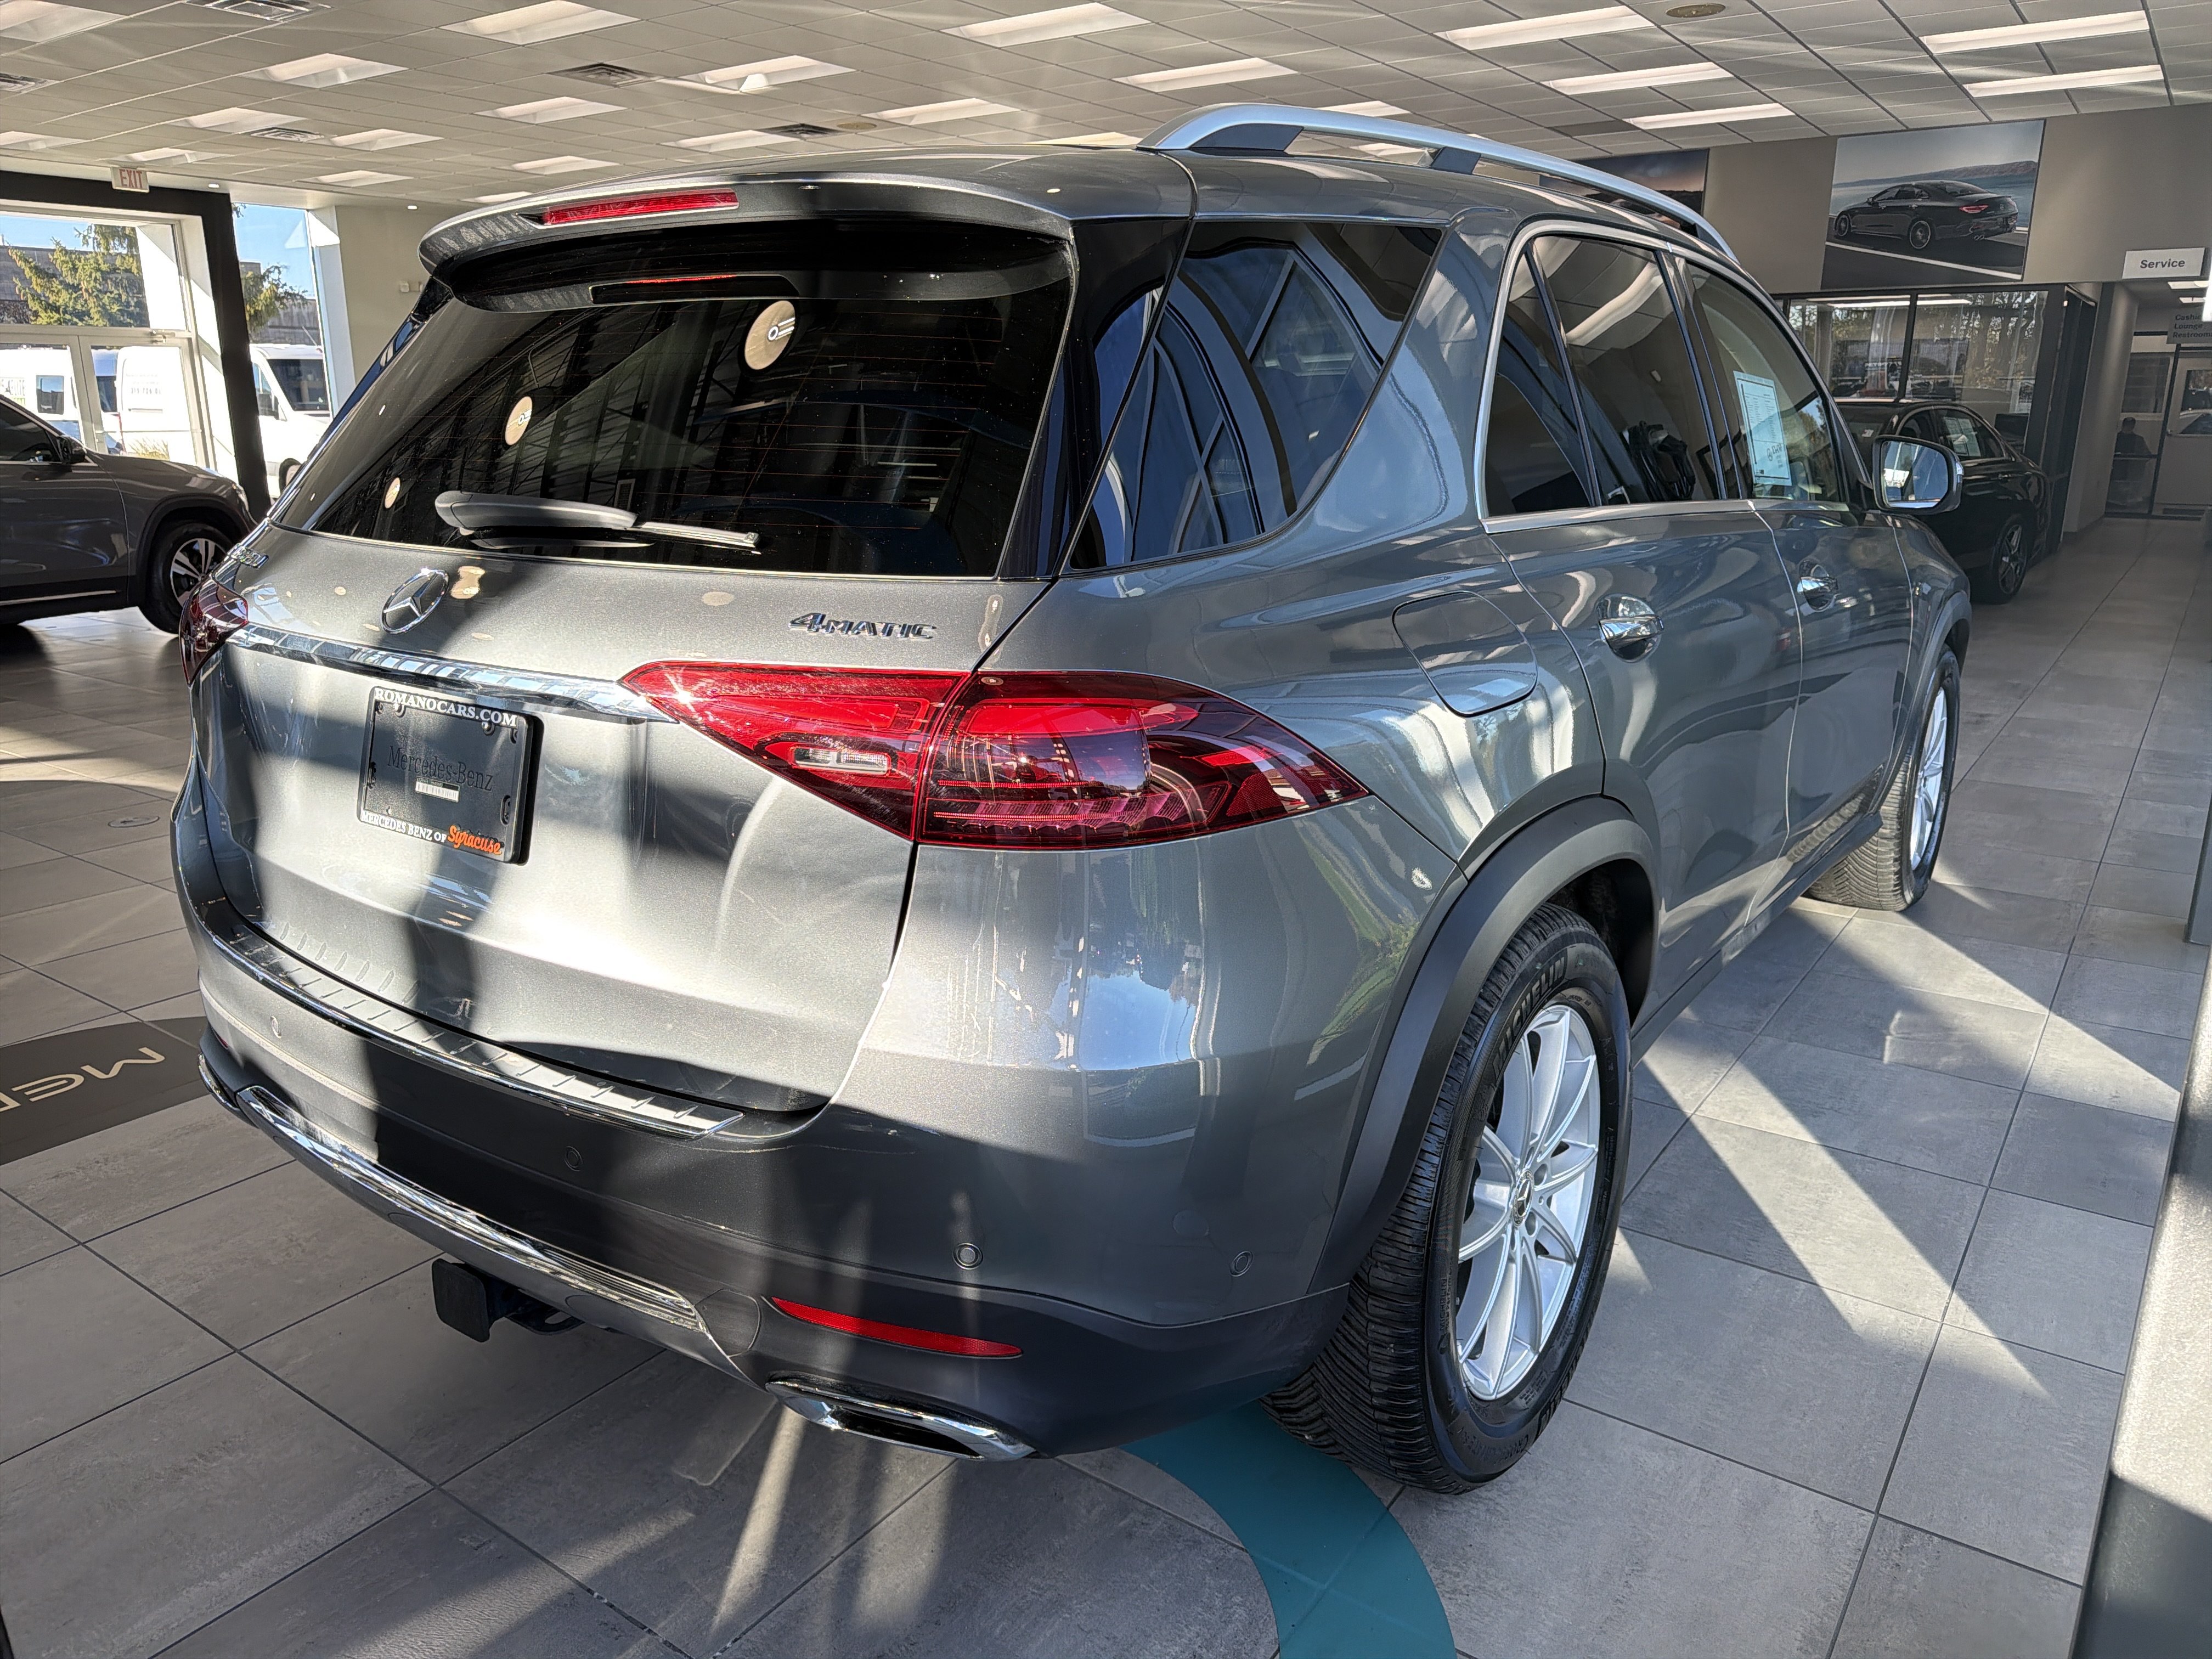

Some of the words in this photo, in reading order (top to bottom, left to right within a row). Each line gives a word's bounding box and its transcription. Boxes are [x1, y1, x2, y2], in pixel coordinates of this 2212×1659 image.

[119, 168, 143, 189] EXIT
[2140, 258, 2185, 269] Service
[788, 612, 937, 639] 4MATIC
[374, 687, 517, 727] ROMANOCARS.COM
[387, 746, 494, 791] Mercedes-Benz
[360, 811, 407, 833] MERCEDES
[408, 825, 433, 840] BENZ
[433, 832, 447, 843] OF
[448, 825, 502, 855] Syracuse
[1492, 956, 1565, 1081] MICHELIN
